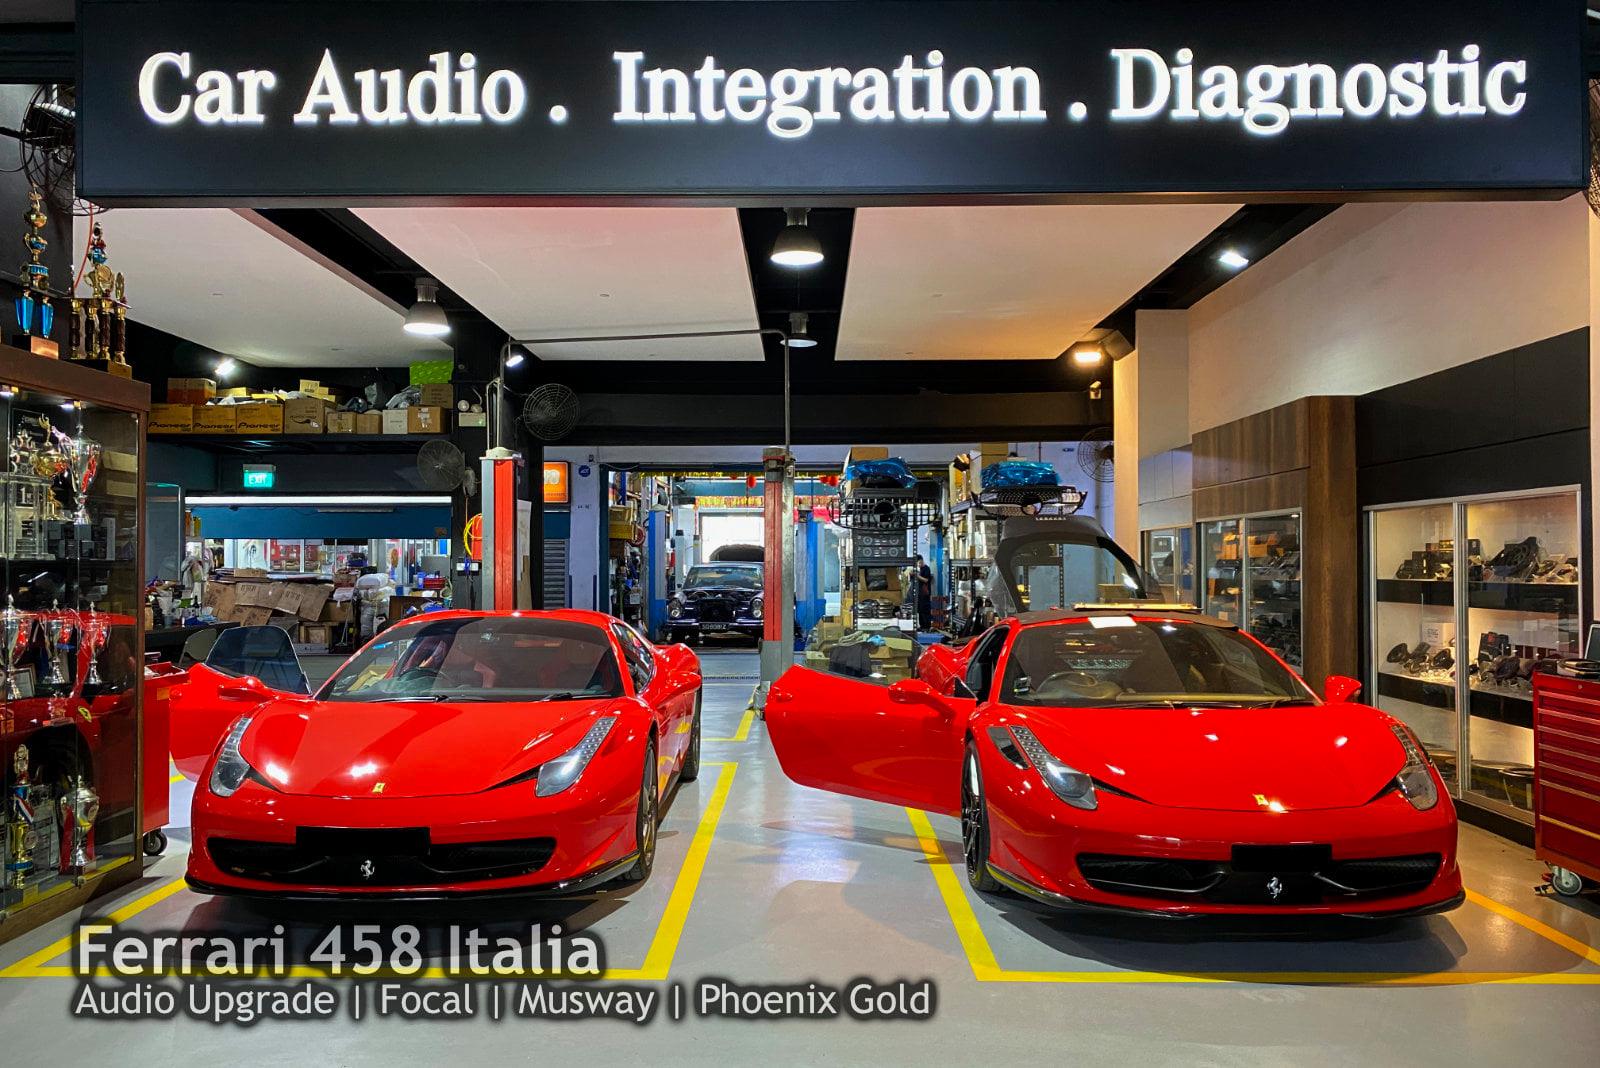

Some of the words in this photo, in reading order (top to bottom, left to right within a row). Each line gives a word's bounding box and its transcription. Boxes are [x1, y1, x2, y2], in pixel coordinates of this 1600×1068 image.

[137, 50, 277, 126] Car
[292, 47, 526, 126] Audio
[612, 48, 1048, 140] Integration
[1109, 43, 1528, 137] Diagnostic
[148, 422, 191, 430] Pioneer
[193, 422, 234, 430] Pioneer
[238, 421, 281, 429] Pioneer
[248, 473, 267, 485] EXIT
